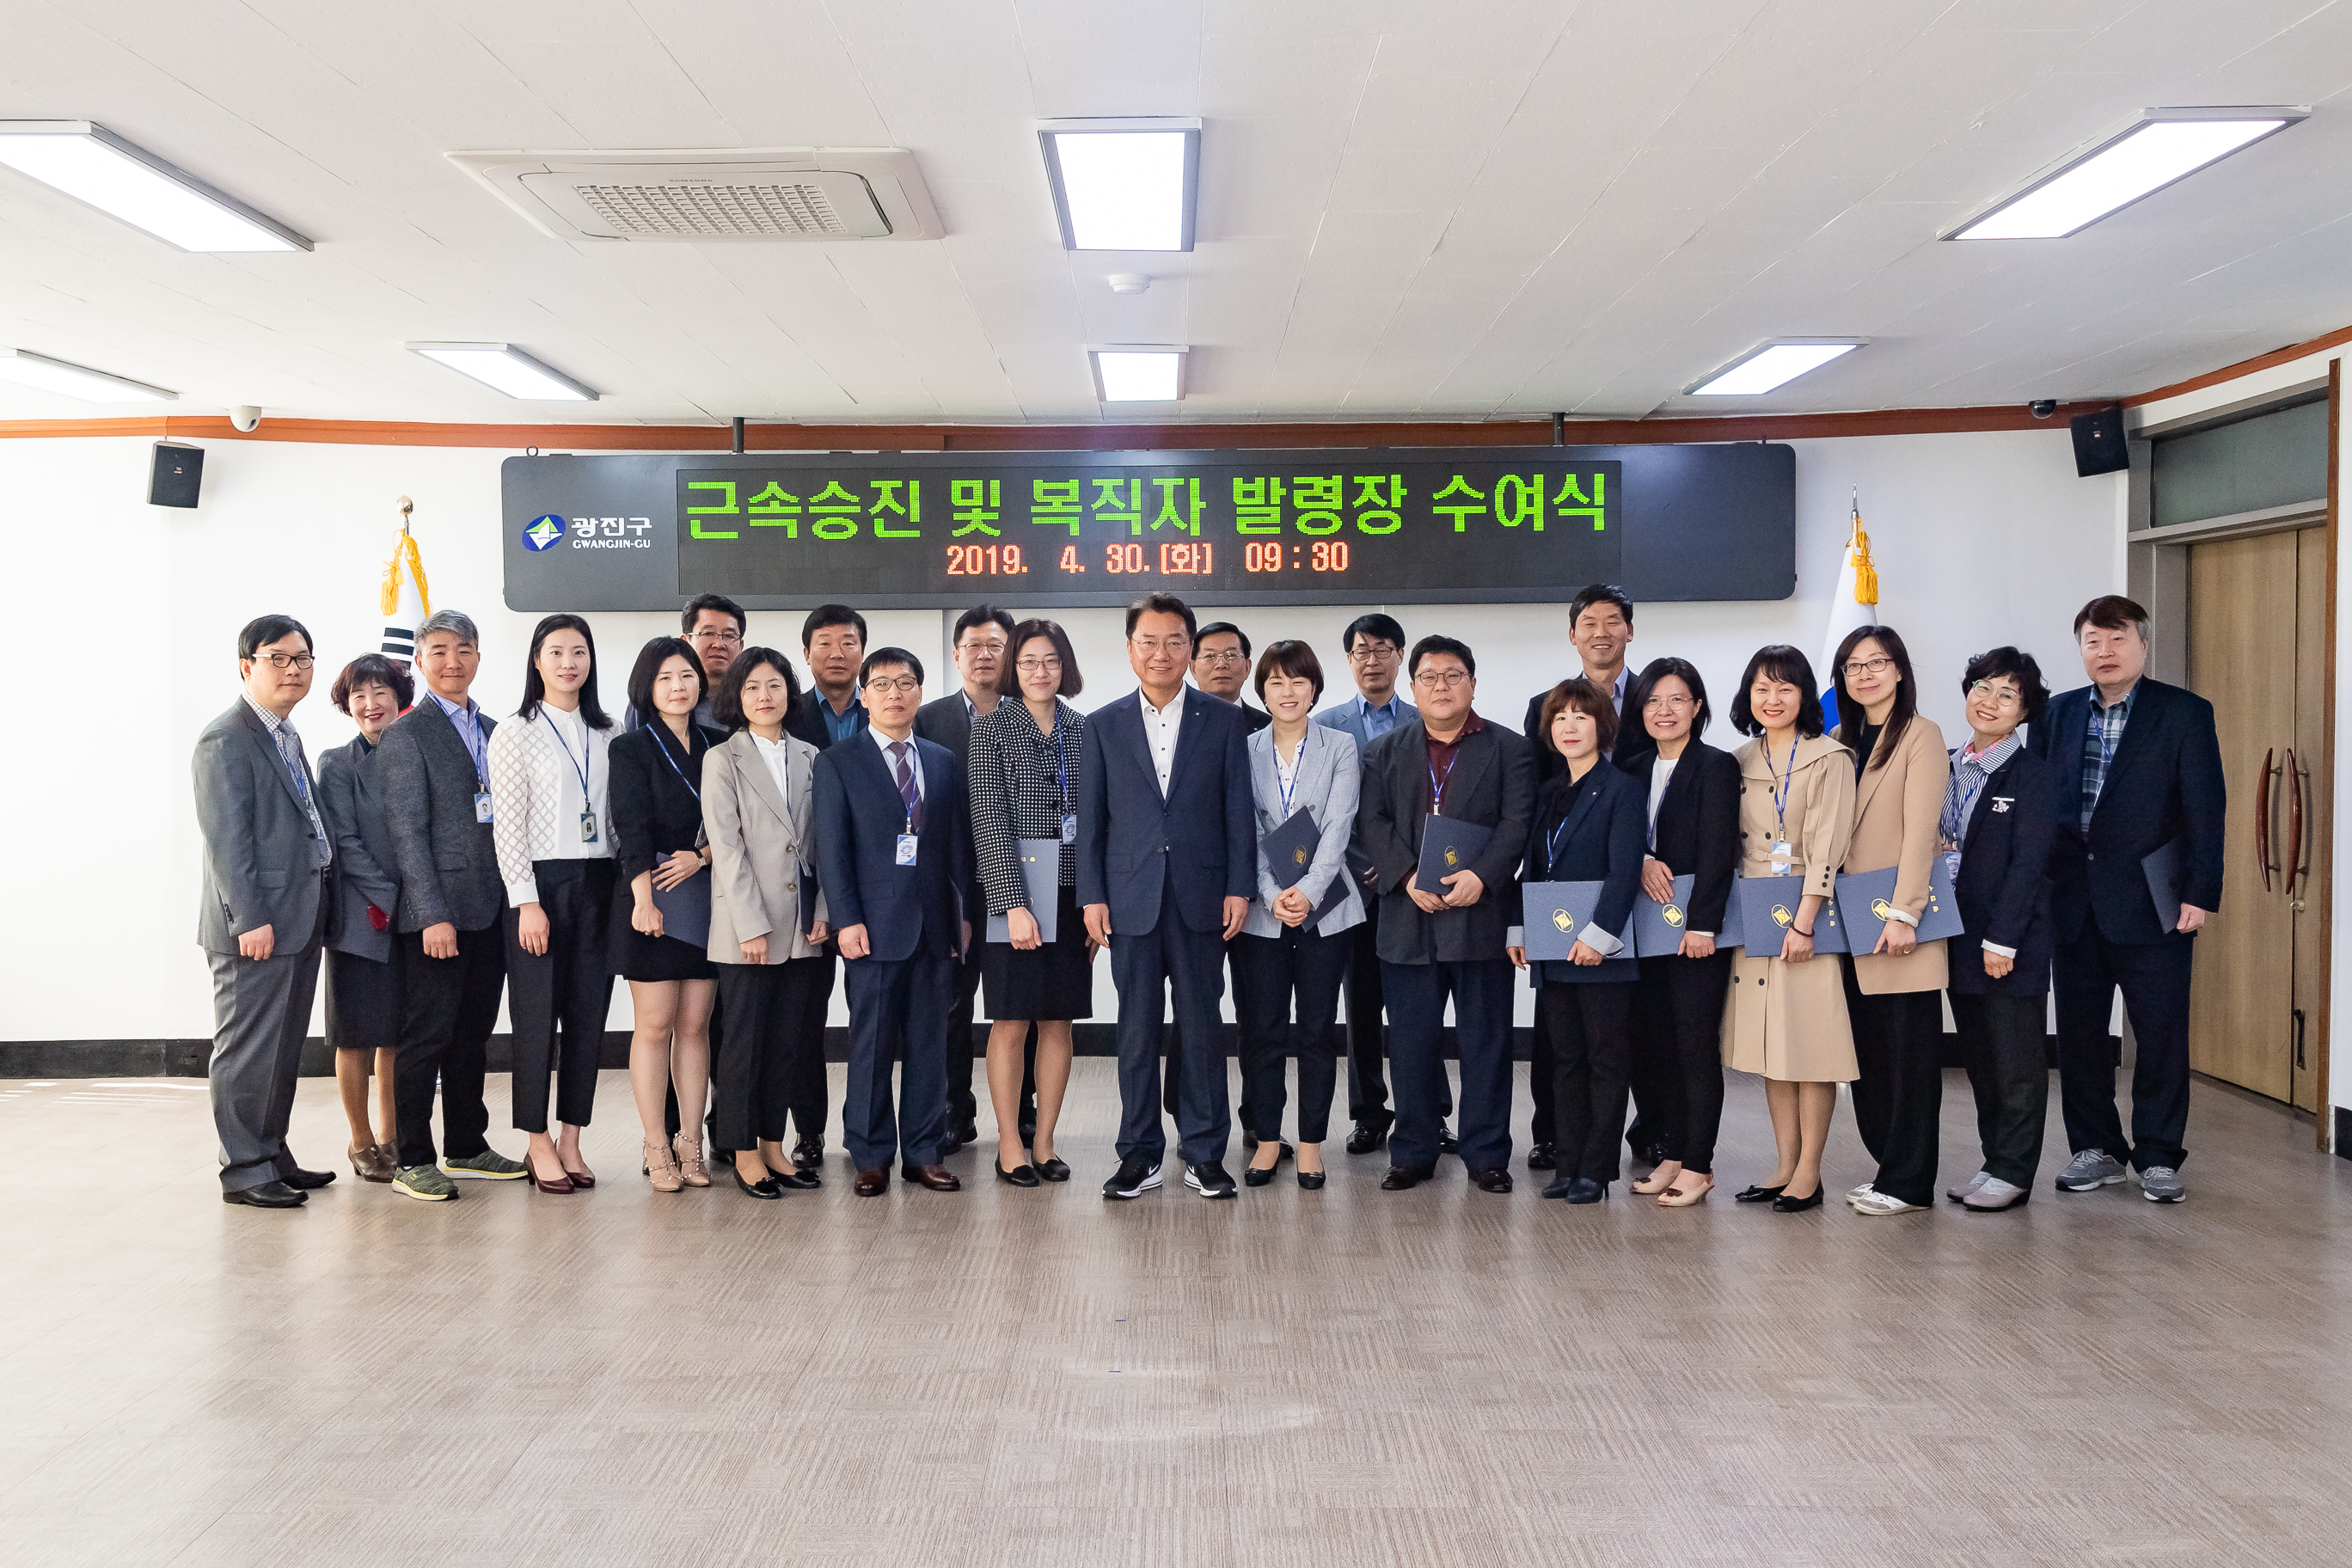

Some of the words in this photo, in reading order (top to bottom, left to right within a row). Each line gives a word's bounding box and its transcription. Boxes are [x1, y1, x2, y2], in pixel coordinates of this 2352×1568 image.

[686, 479, 921, 540] 근속승진
[950, 479, 1001, 537] 및
[1030, 477, 1207, 536] 복직자
[1233, 474, 1408, 536] 발령장
[1432, 473, 1605, 532] 수여식
[571, 517, 652, 538] 광진구
[572, 539, 651, 549] GWANGJIN-GU
[946, 543, 1029, 576] 2019.
[1059, 544, 1086, 574] 4.
